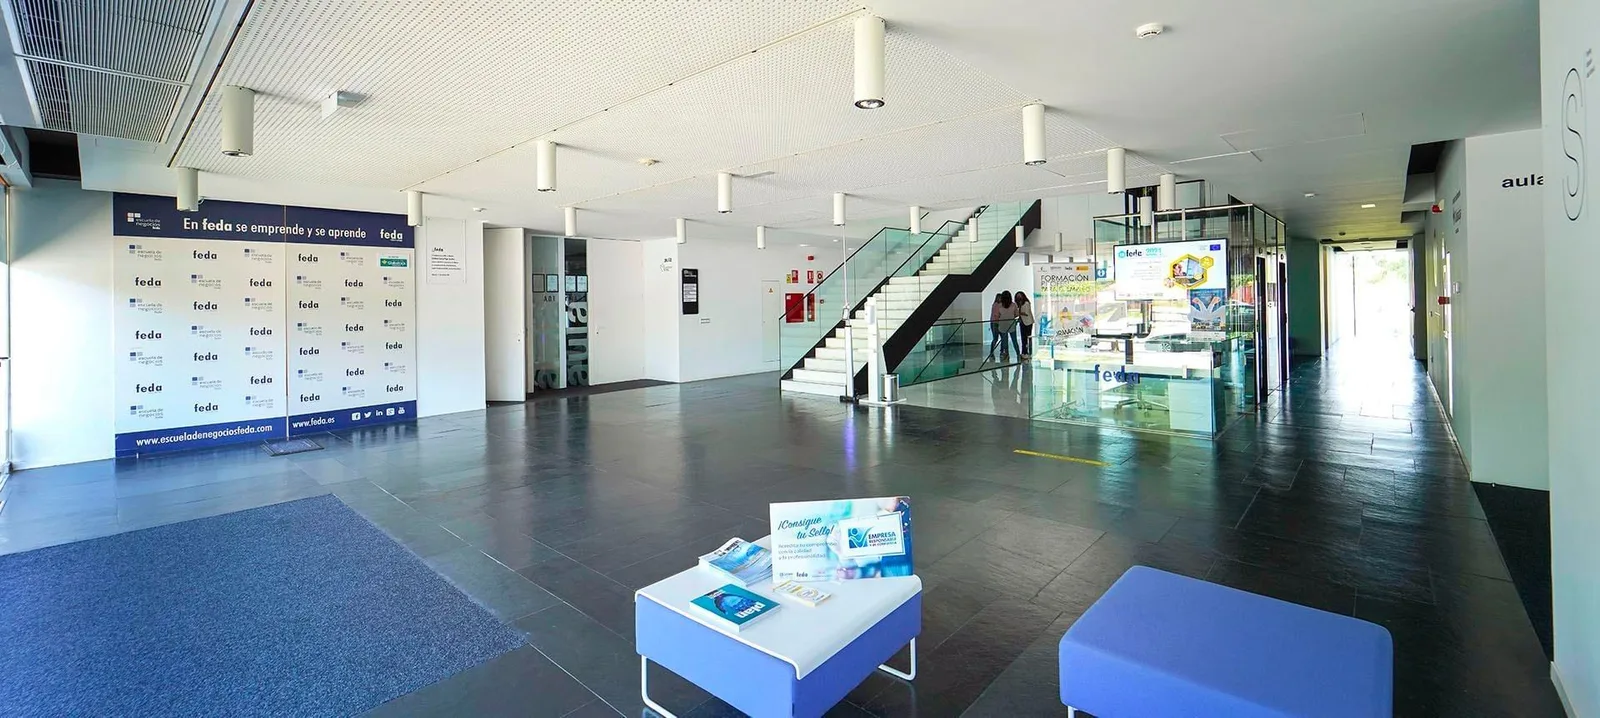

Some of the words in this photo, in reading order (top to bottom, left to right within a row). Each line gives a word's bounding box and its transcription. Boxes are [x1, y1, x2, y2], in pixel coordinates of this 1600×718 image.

[183, 217, 199, 230] En
[202, 218, 233, 232] feda
[235, 223, 248, 233] se
[250, 223, 305, 236] emprende
[307, 228, 313, 238] y
[315, 227, 326, 236] se
[328, 227, 367, 239] aprende
[379, 228, 403, 240] feda
[193, 250, 218, 260] feda
[298, 254, 318, 262] feda
[135, 277, 162, 286] feda
[250, 278, 272, 286] feda
[344, 279, 364, 287] feda
[194, 301, 218, 310] feda
[298, 300, 319, 308] feda
[250, 327, 272, 336] feda
[346, 324, 364, 332] feda
[136, 330, 162, 340] feda
[299, 347, 320, 356] feda
[194, 352, 218, 361] feda
[346, 368, 364, 376] feda
[250, 376, 272, 384] feda
[136, 382, 162, 392] feda
[386, 384, 404, 392] feda
[300, 394, 320, 402] feda
[194, 402, 218, 412] feda
[292, 416, 336, 428] www.feda.es
[136, 424, 273, 446] www.escueladenegociosfeda.com
[868, 532, 896, 540] EMPRESA
